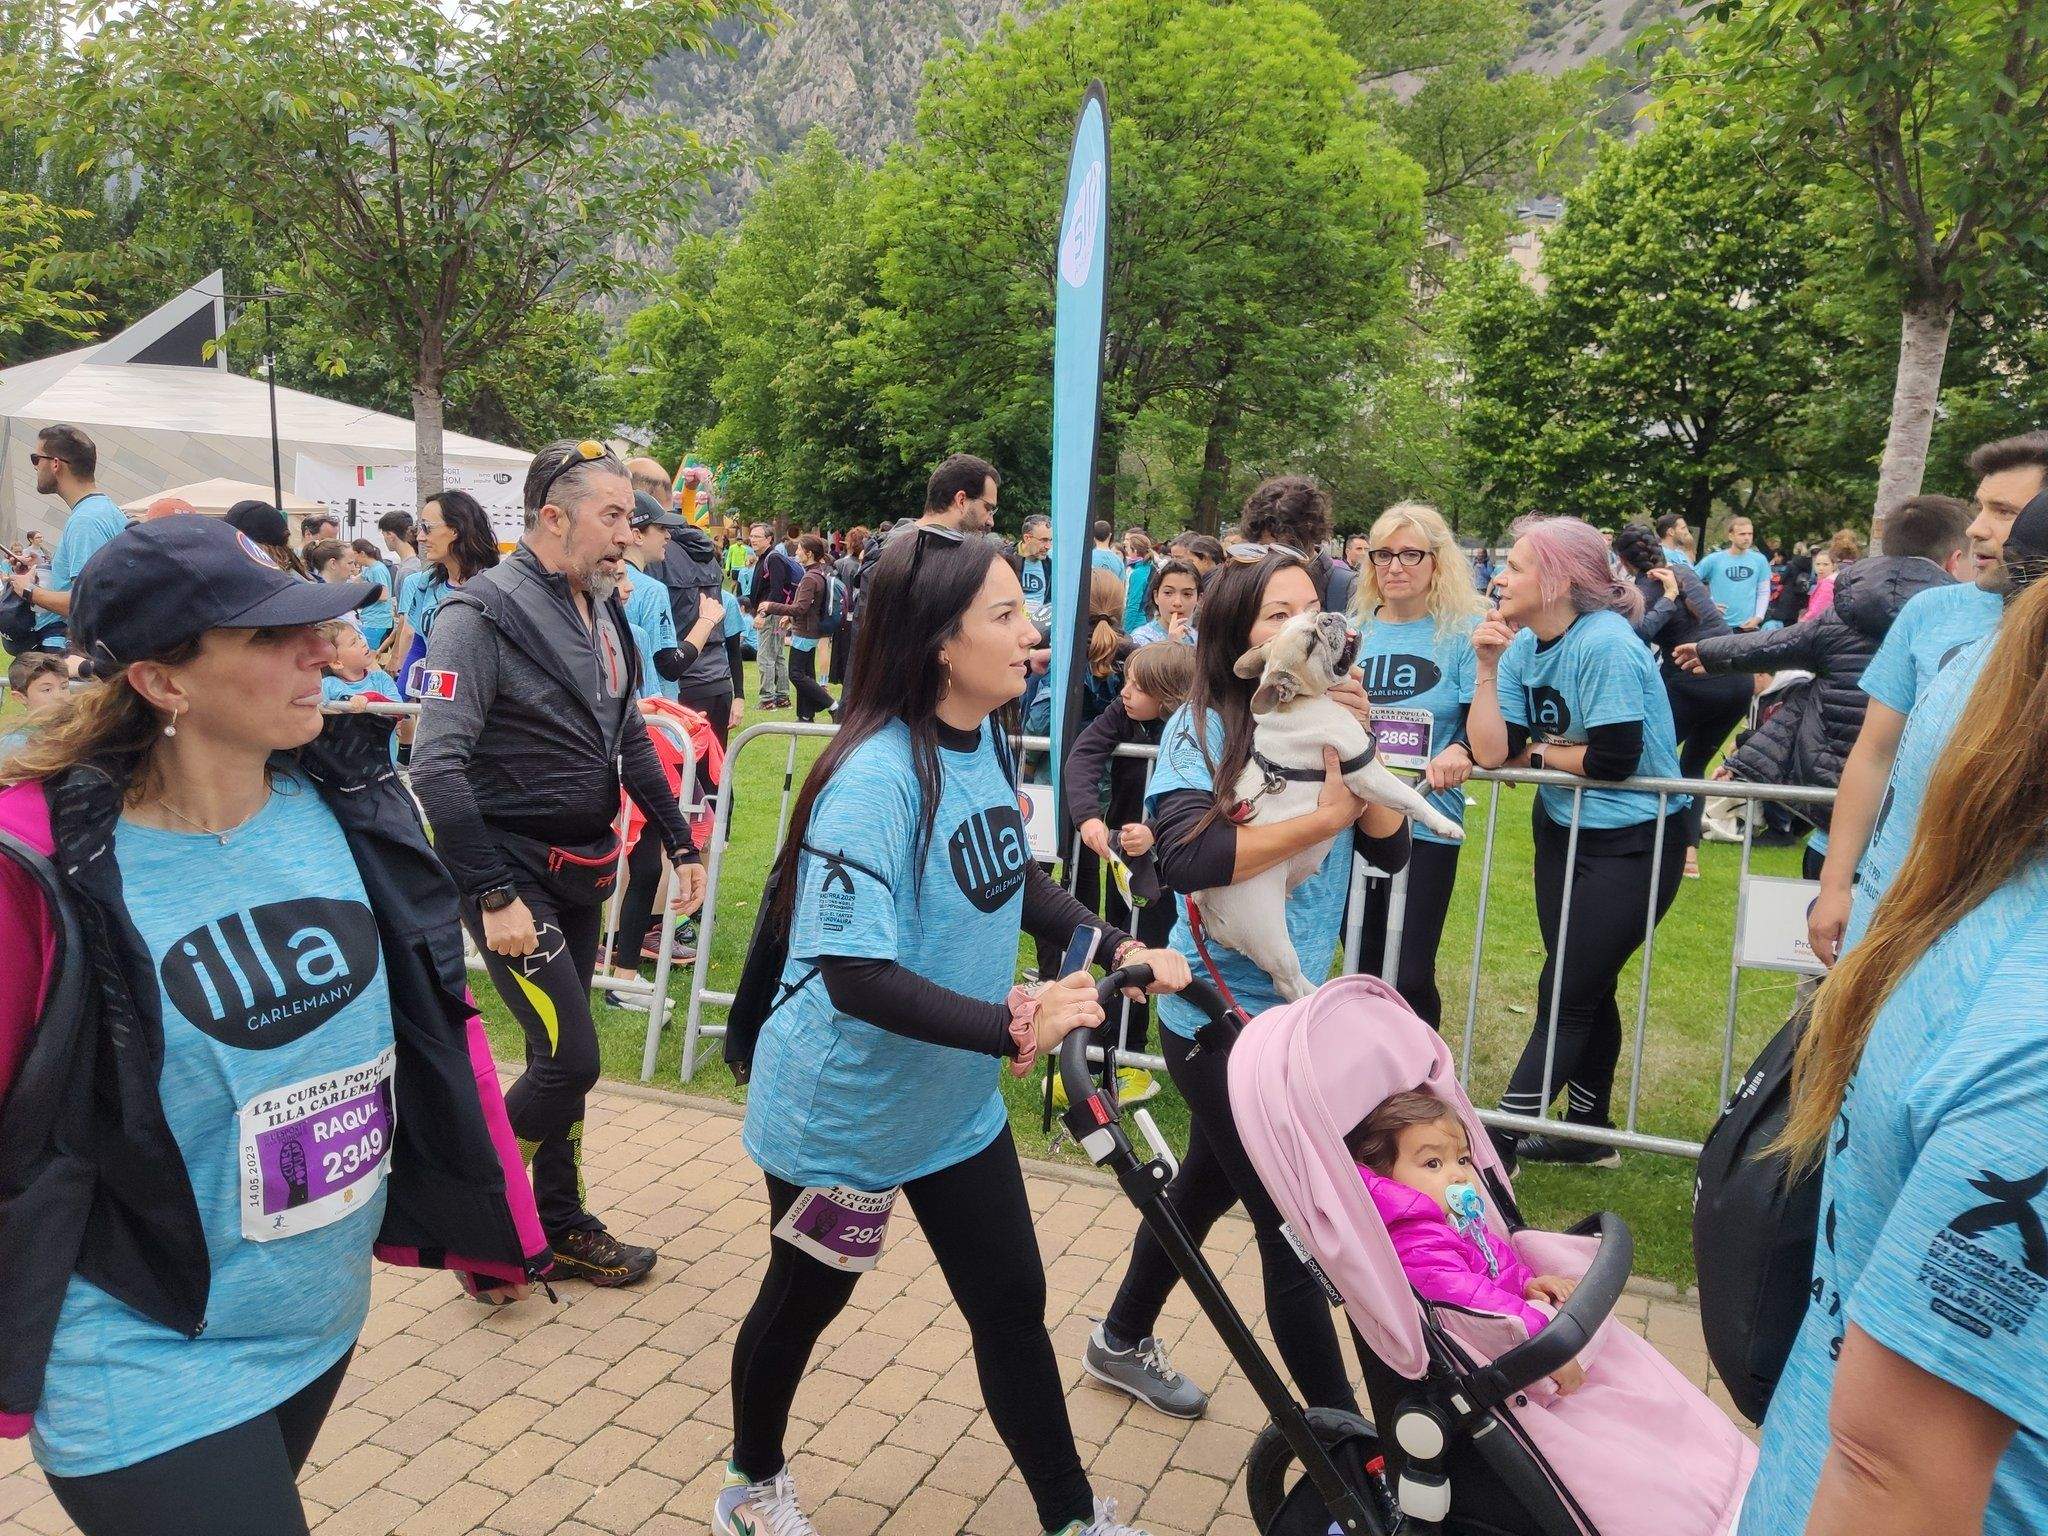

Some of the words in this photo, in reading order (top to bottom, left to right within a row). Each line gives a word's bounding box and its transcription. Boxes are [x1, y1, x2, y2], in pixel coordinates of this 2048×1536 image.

[1022, 574, 1039, 590] lla
[1528, 686, 1559, 724] la
[1379, 730, 1419, 746] 2865
[957, 811, 1024, 890] illa
[985, 871, 1025, 899] CARLEMANY
[183, 911, 350, 1020] illa
[247, 983, 353, 1031] CARLEMANY
[253, 1100, 281, 1117] 12a
[287, 1079, 338, 1106] CURSA
[268, 1107, 307, 1128] ILLA
[322, 1127, 384, 1184] 2349
[246, 1144, 260, 1208] 14.05.2023
[788, 1193, 812, 1222] 14.05.2023
[828, 1193, 855, 1209] ILLA
[846, 1192, 885, 1206] CURSA
[1936, 1229, 2007, 1272] ANDORRA
